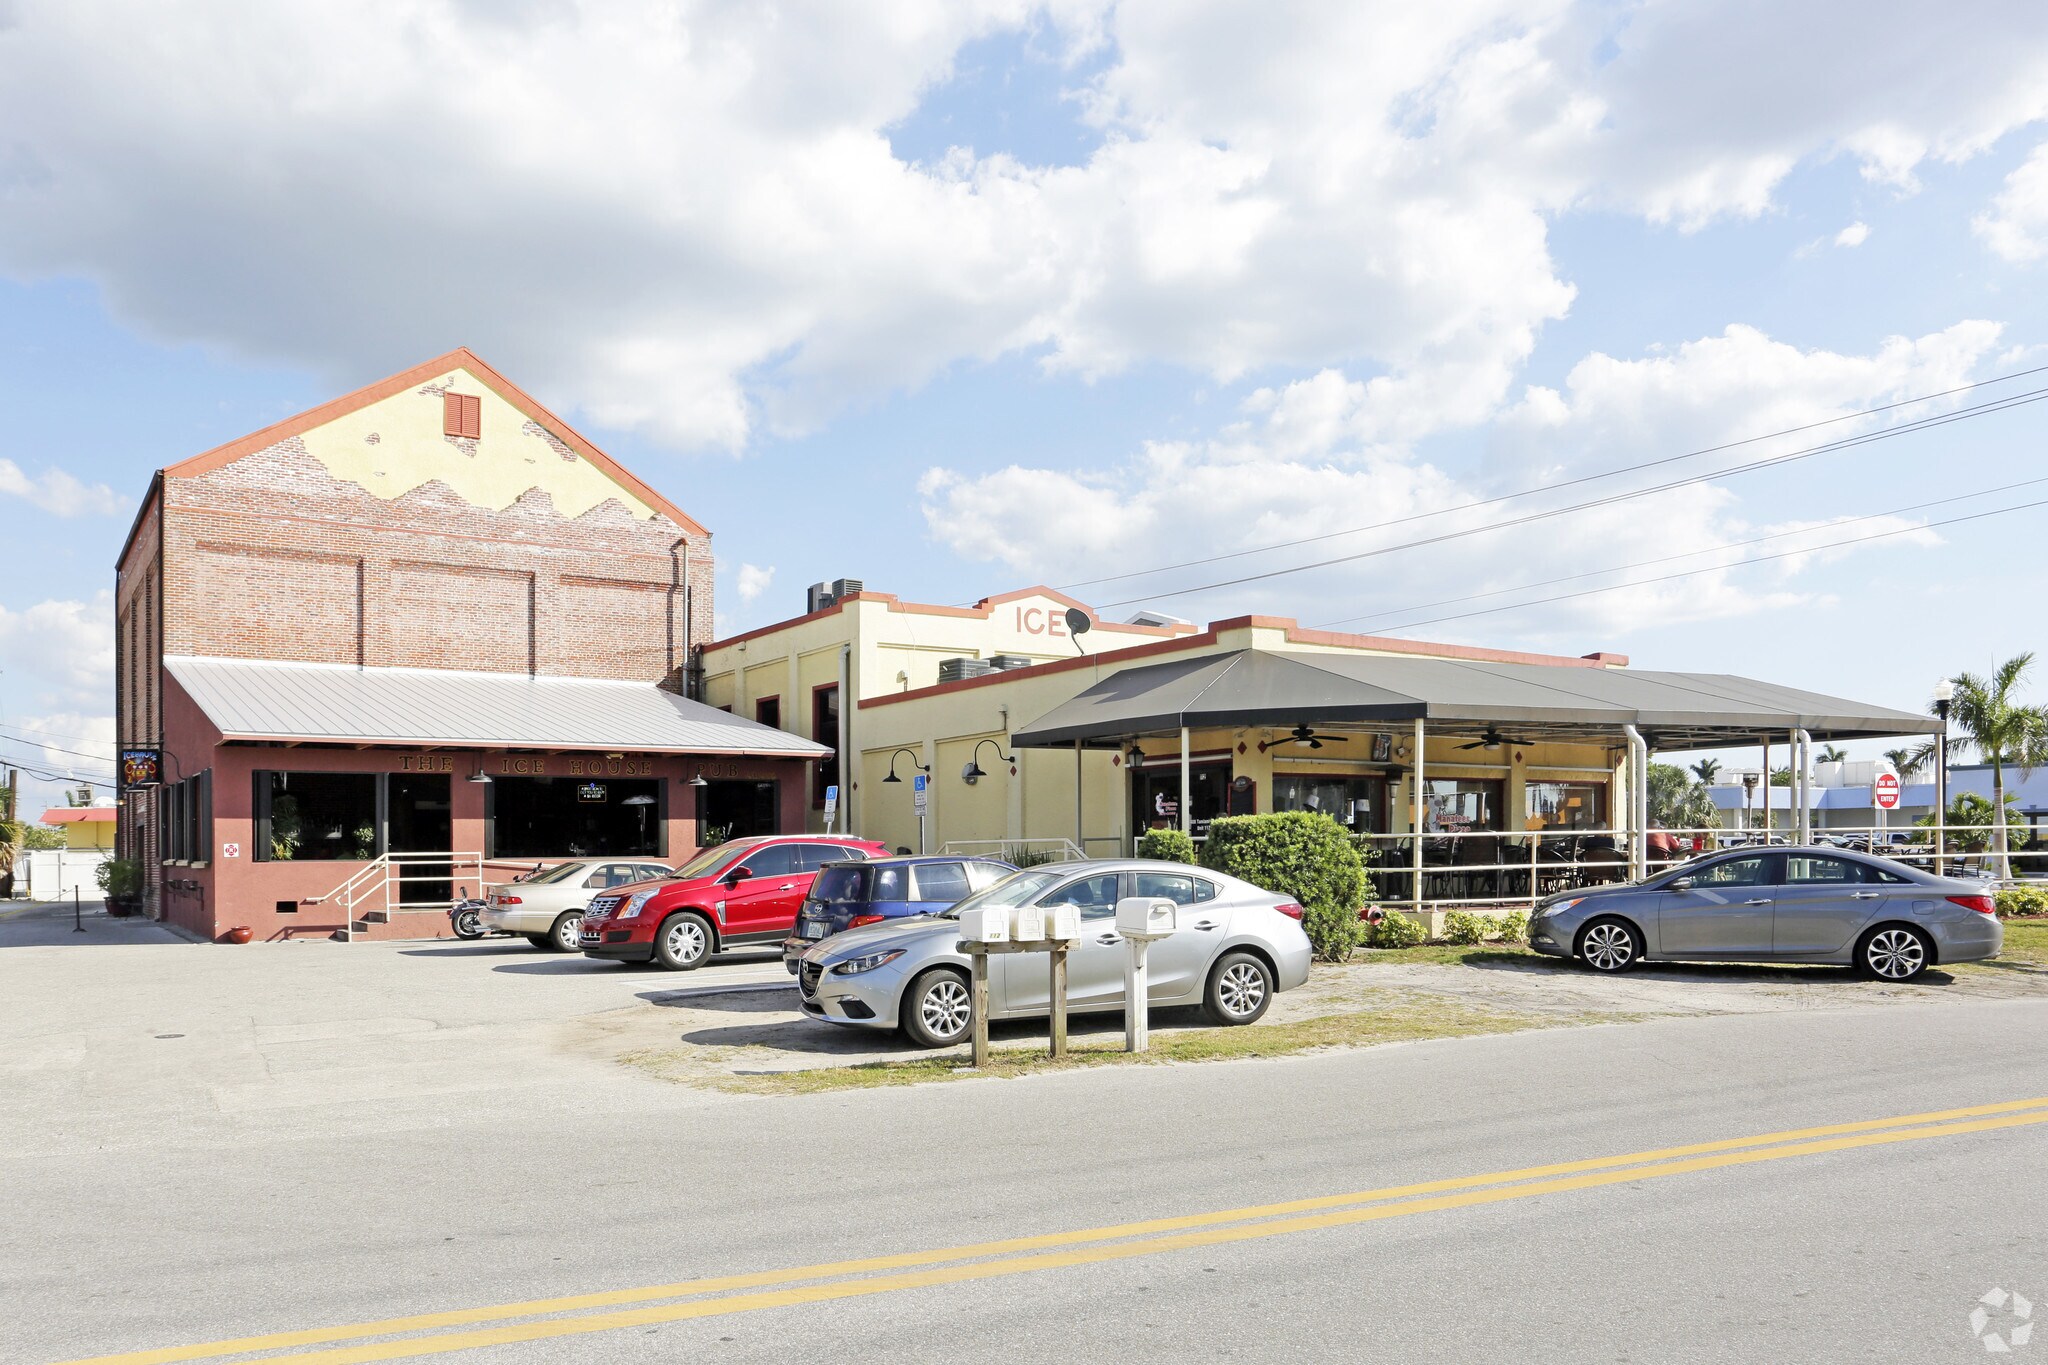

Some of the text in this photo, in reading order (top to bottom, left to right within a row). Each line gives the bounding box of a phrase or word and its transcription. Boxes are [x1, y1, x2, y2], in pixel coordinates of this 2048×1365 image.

[1016, 606, 1067, 637] ICE
[399, 755, 453, 772] THE
[501, 758, 545, 773] ICE
[569, 760, 652, 775] HOUSE
[697, 763, 738, 777] PUB
[1436, 813, 1471, 824] Manatees
